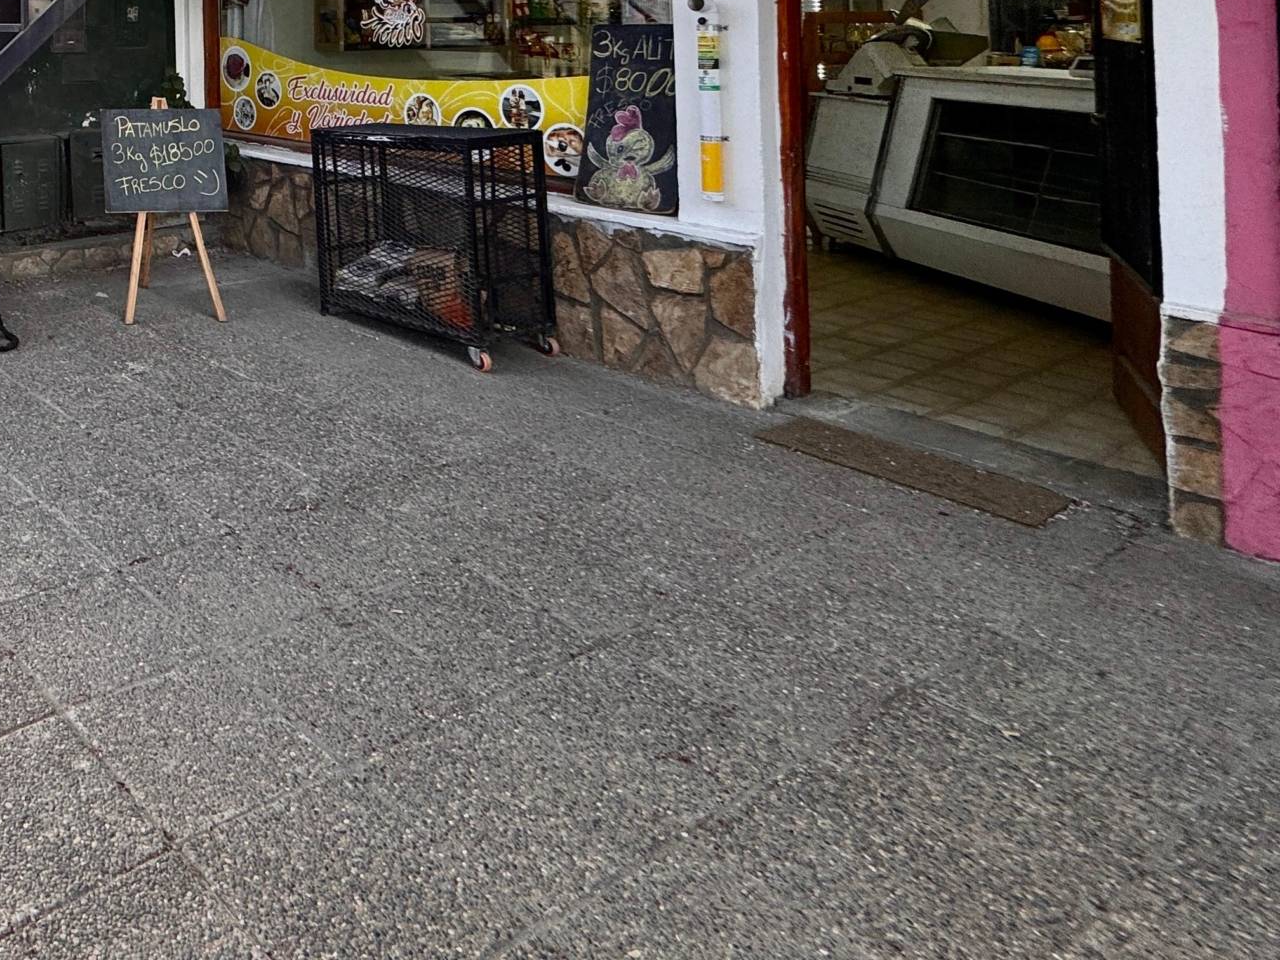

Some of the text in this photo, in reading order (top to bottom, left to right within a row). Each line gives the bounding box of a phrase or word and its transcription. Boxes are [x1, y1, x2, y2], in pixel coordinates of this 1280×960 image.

[287, 74, 394, 107] Exclusividad
[114, 115, 201, 139] PATAMUSLO
[286, 111, 302, 134] y
[150, 139, 215, 170] $18500
[114, 174, 186, 197] FRESCO
